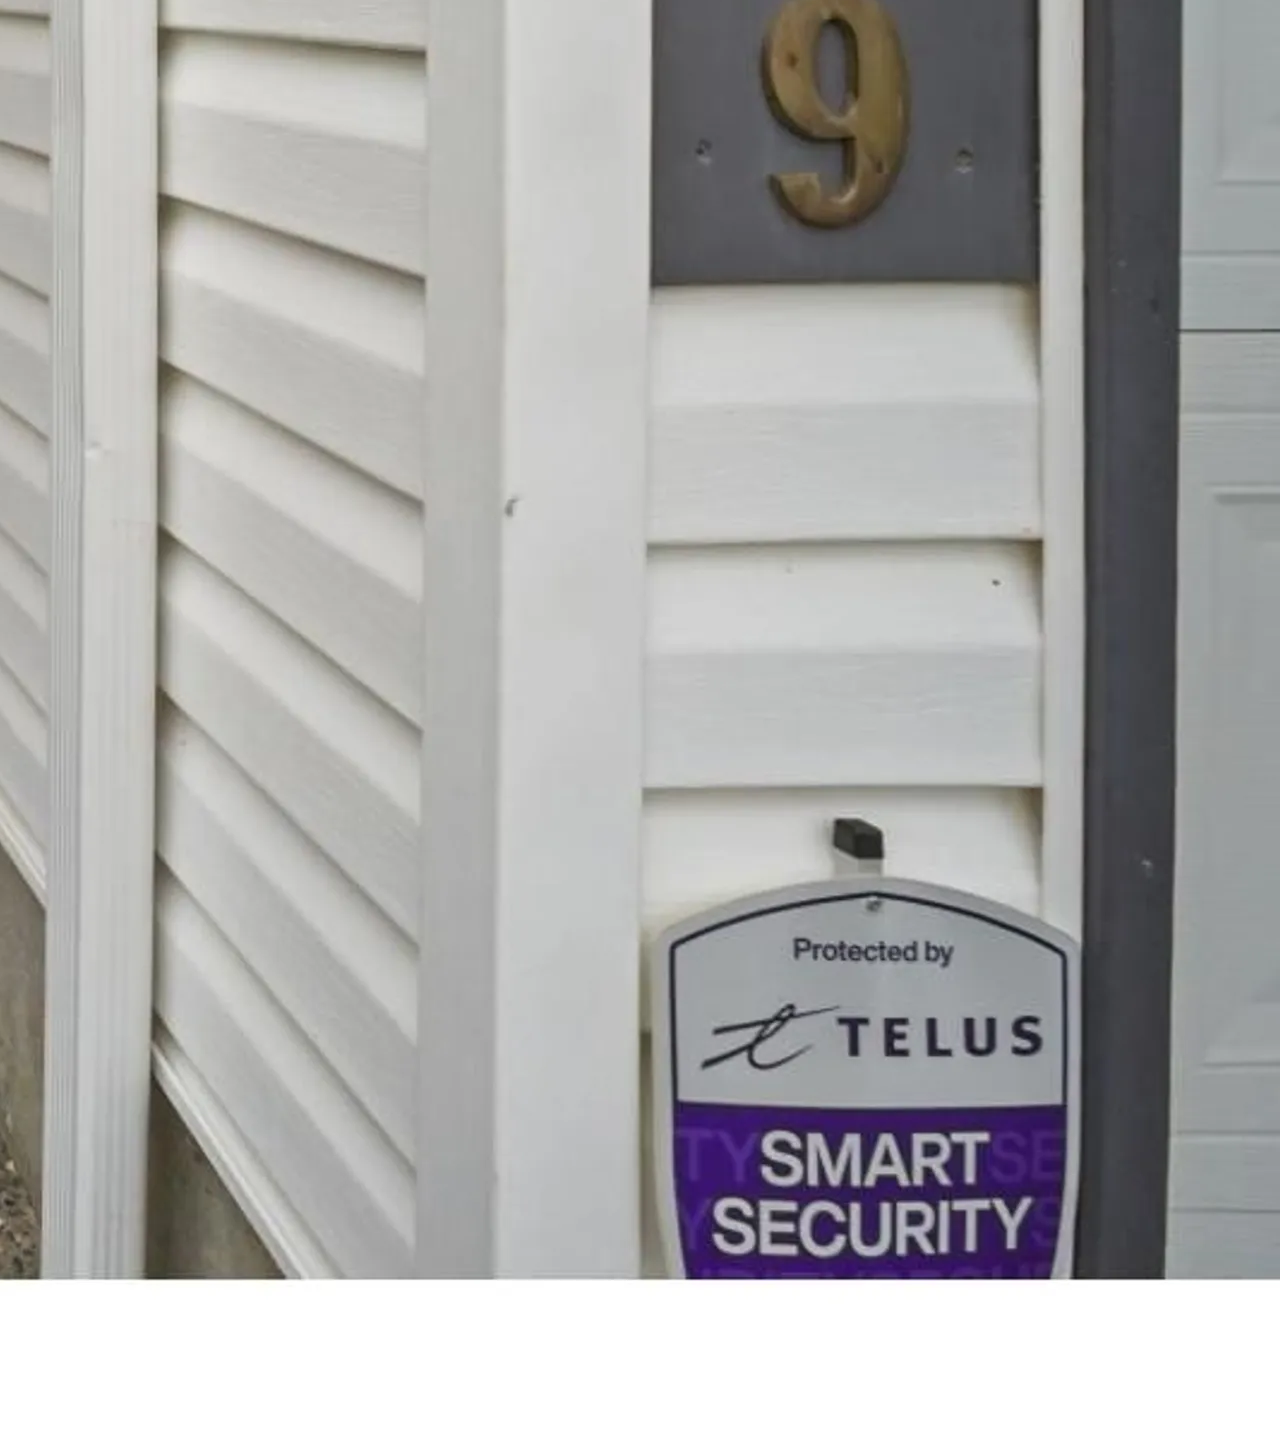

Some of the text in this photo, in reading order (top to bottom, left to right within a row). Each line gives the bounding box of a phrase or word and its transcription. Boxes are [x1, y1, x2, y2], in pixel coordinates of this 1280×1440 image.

[792, 937, 954, 968] Protected by
[837, 1015, 1044, 1058] TELUS
[760, 1129, 991, 1188] SMART
[711, 1196, 1034, 1258] SECURITY
